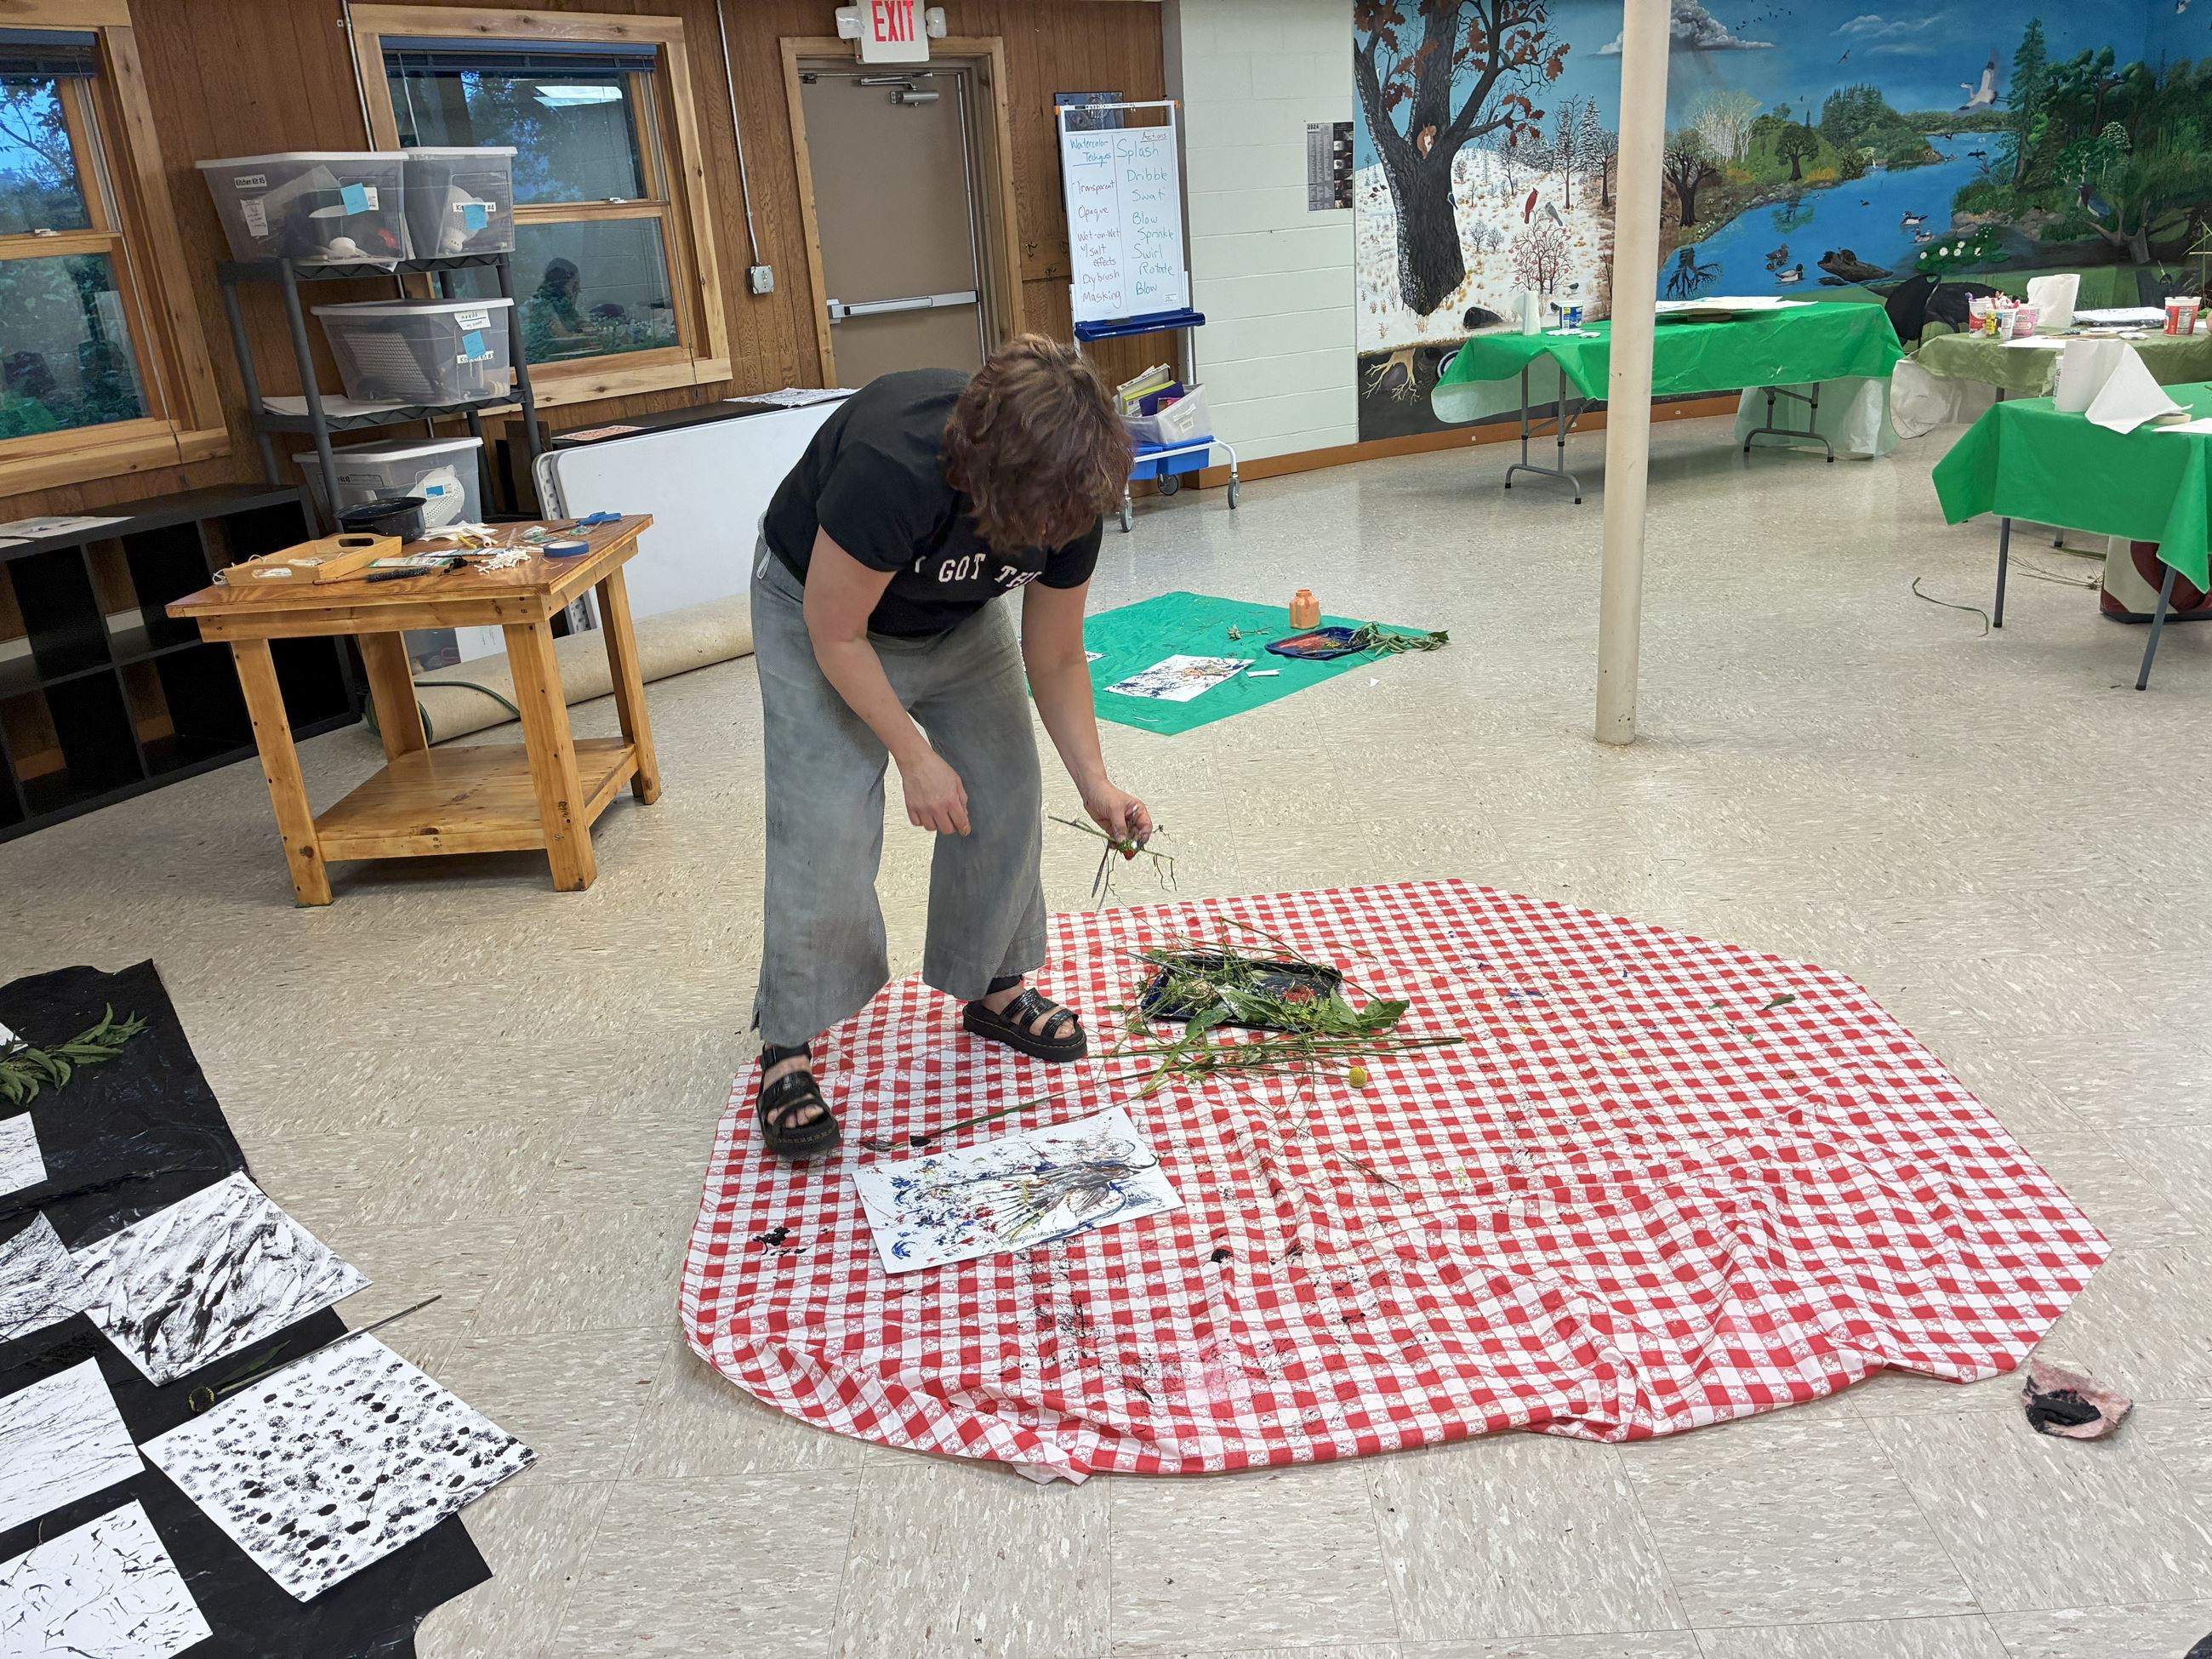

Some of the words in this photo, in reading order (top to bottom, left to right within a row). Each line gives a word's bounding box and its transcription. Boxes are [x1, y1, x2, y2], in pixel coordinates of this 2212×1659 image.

[871, 0, 915, 42] EXIT
[1115, 139, 1159, 165] Splash
[1126, 168, 1168, 182] Dribble
[1072, 180, 1115, 195] Transparent
[1132, 188, 1166, 202] Swat
[1078, 204, 1109, 223] Opaque
[1132, 211, 1158, 225] Blow
[1132, 243, 1163, 259] Swirl
[1093, 256, 1117, 268] effects
[1139, 261, 1175, 276] Rotate
[1136, 281, 1158, 296] Blow
[1082, 290, 1122, 310] Masking
[938, 553, 986, 583] GOT
